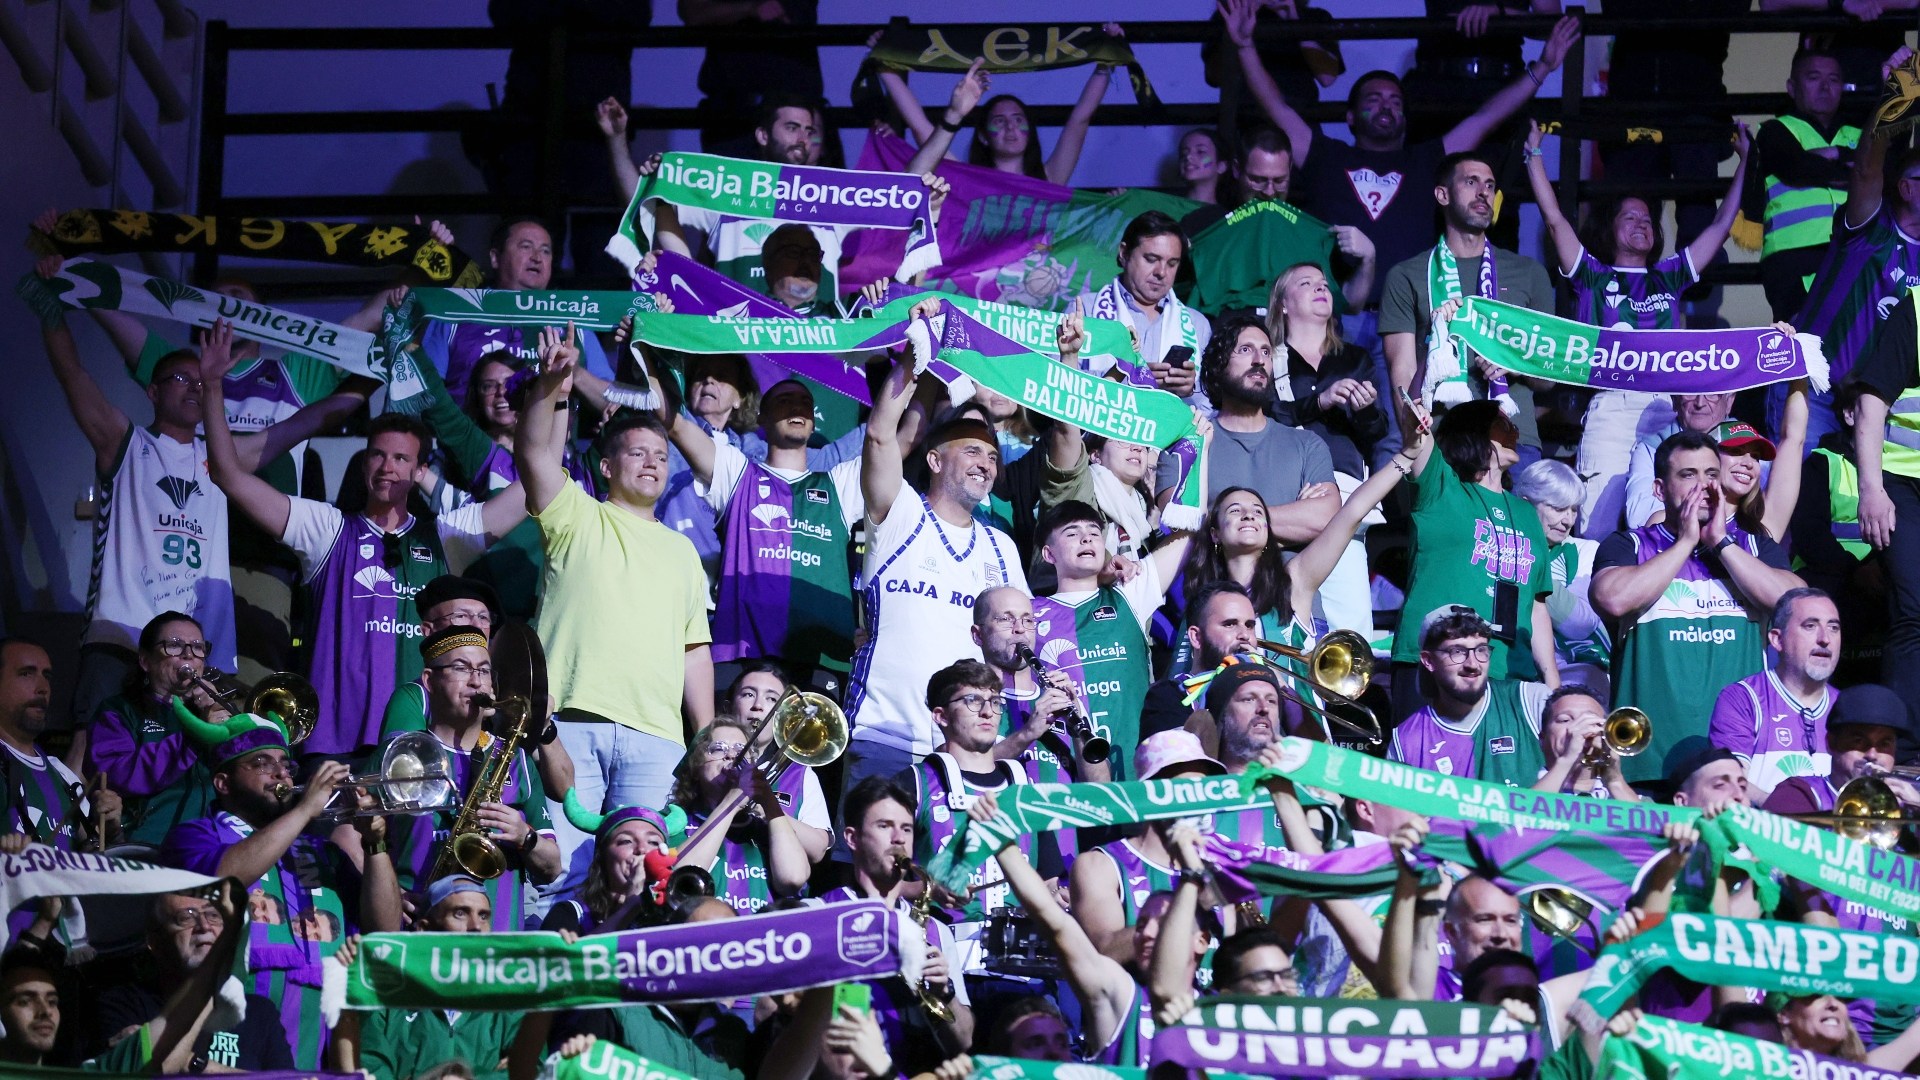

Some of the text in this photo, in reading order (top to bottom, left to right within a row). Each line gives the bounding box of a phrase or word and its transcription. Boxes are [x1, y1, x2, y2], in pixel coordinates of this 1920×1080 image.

[655, 158, 923, 210] nicaja Baloncesto
[217, 296, 337, 347] Unicaja
[515, 294, 600, 317] Unicaja
[1452, 298, 1740, 373] Unicaja Baloncesto
[1046, 363, 1139, 413] UNICAJA
[1023, 378, 1157, 441] BALONCESTO
[159, 513, 203, 534] Unicaja
[786, 519, 832, 538] Unicaja
[162, 534, 202, 569] 93
[886, 579, 975, 609] CAJA RO
[1076, 642, 1127, 660] Unicaja
[1075, 680, 1121, 697] álaga
[1023, 747, 1061, 769] nicaj
[1144, 777, 1242, 806] Unica
[1359, 757, 1507, 810] UNICAJA
[1064, 795, 1114, 822] Unicaja
[1732, 803, 1867, 876] UNICAJA
[1820, 864, 1846, 886] COPA
[1848, 875, 1867, 894] DEL
[1868, 882, 1891, 901] REY
[431, 946, 572, 993] Unicaja
[582, 929, 812, 979] Baloncesto
[1671, 913, 1920, 984] CAMPEO
[1780, 975, 1810, 988] ACB
[1182, 1003, 1526, 1069] UNICAJA
